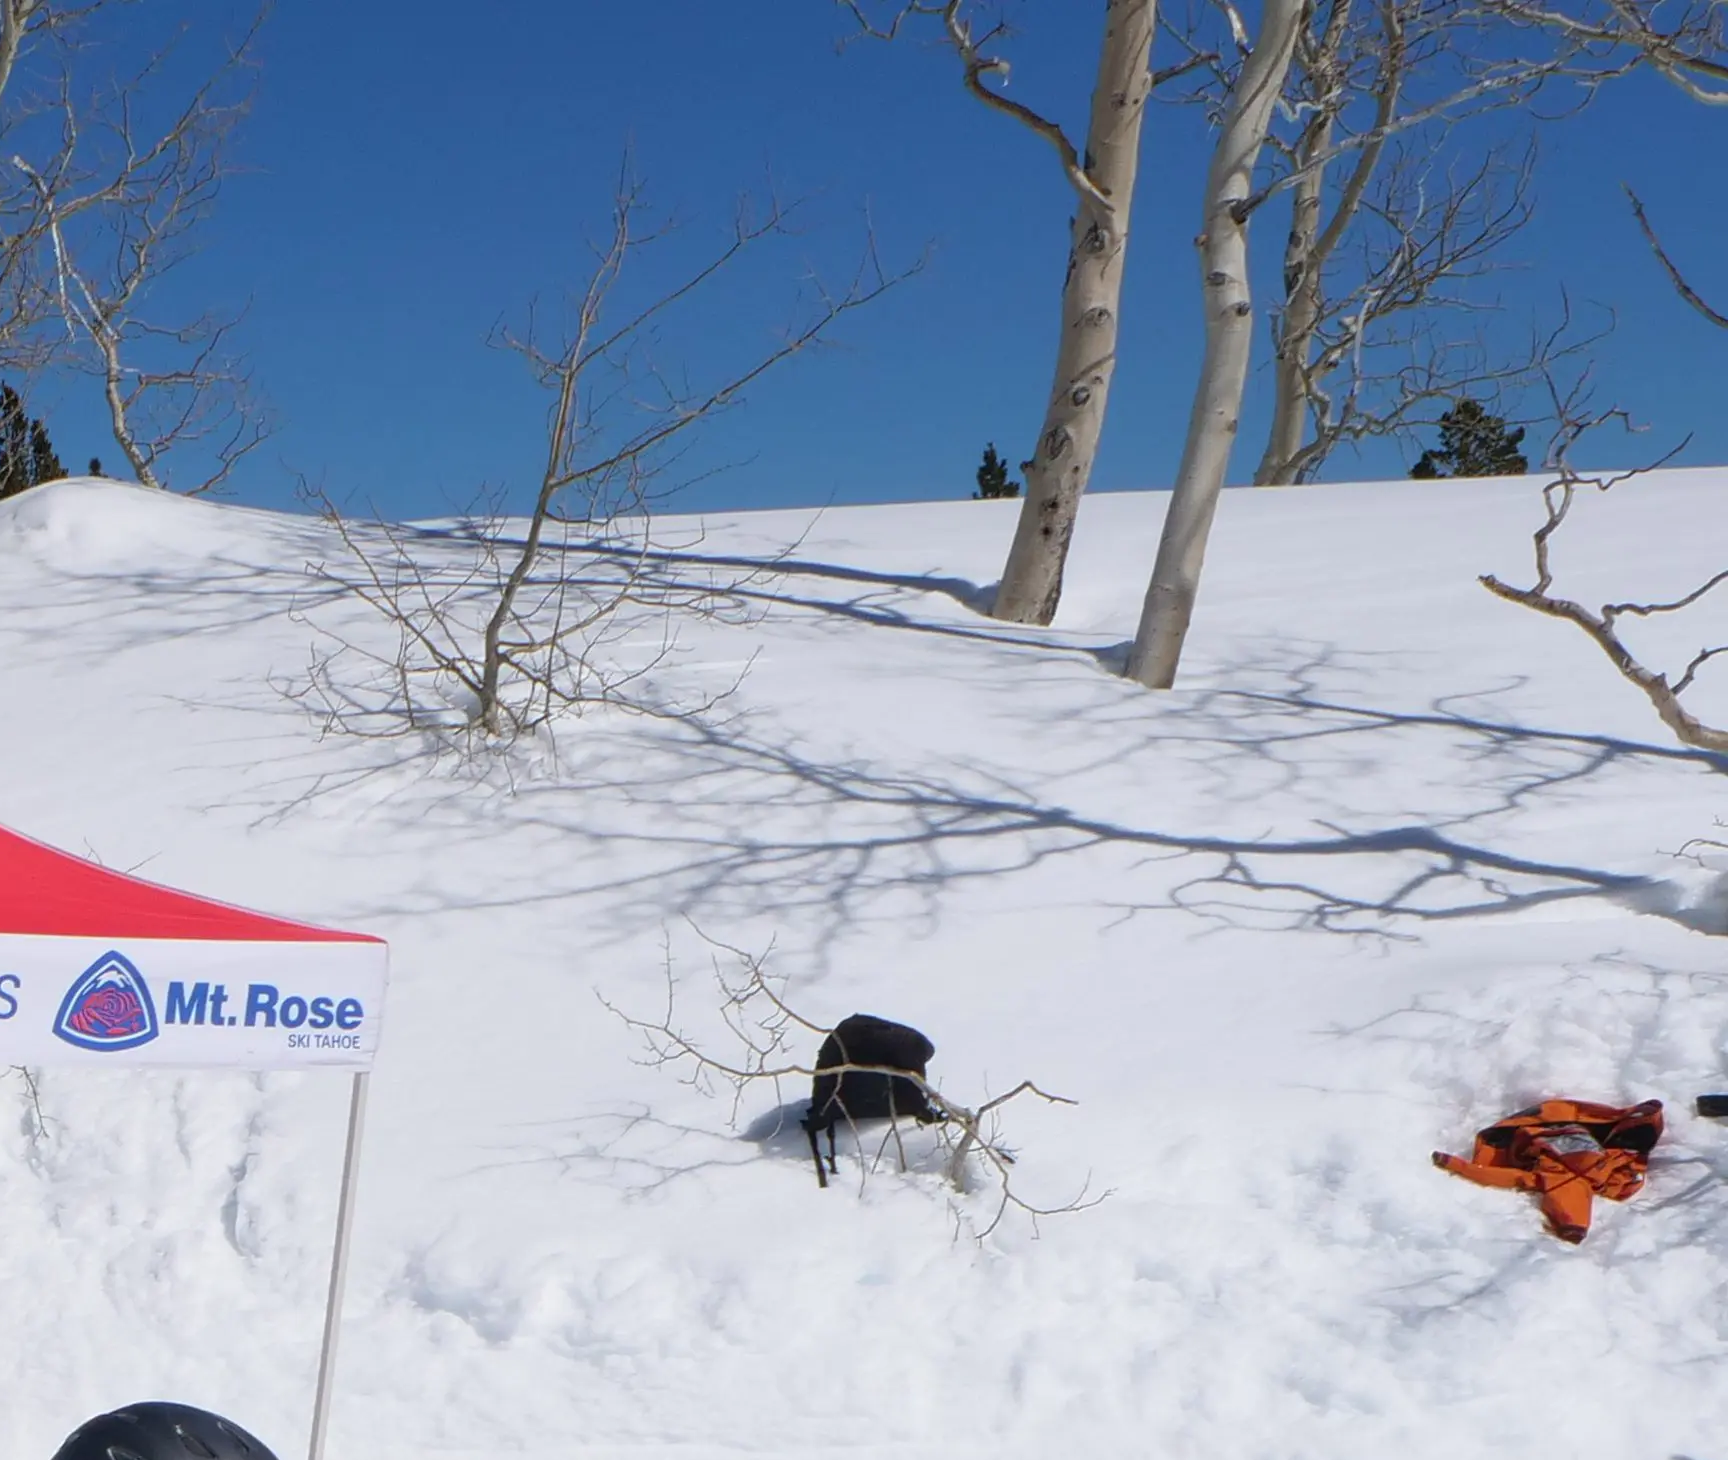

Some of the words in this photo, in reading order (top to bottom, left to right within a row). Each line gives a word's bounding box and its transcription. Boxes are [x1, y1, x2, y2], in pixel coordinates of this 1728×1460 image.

[164, 981, 237, 1026] Mt.
[244, 984, 364, 1031] Rose
[287, 1034, 311, 1049] SKI
[314, 1034, 361, 1050] TAHOE
